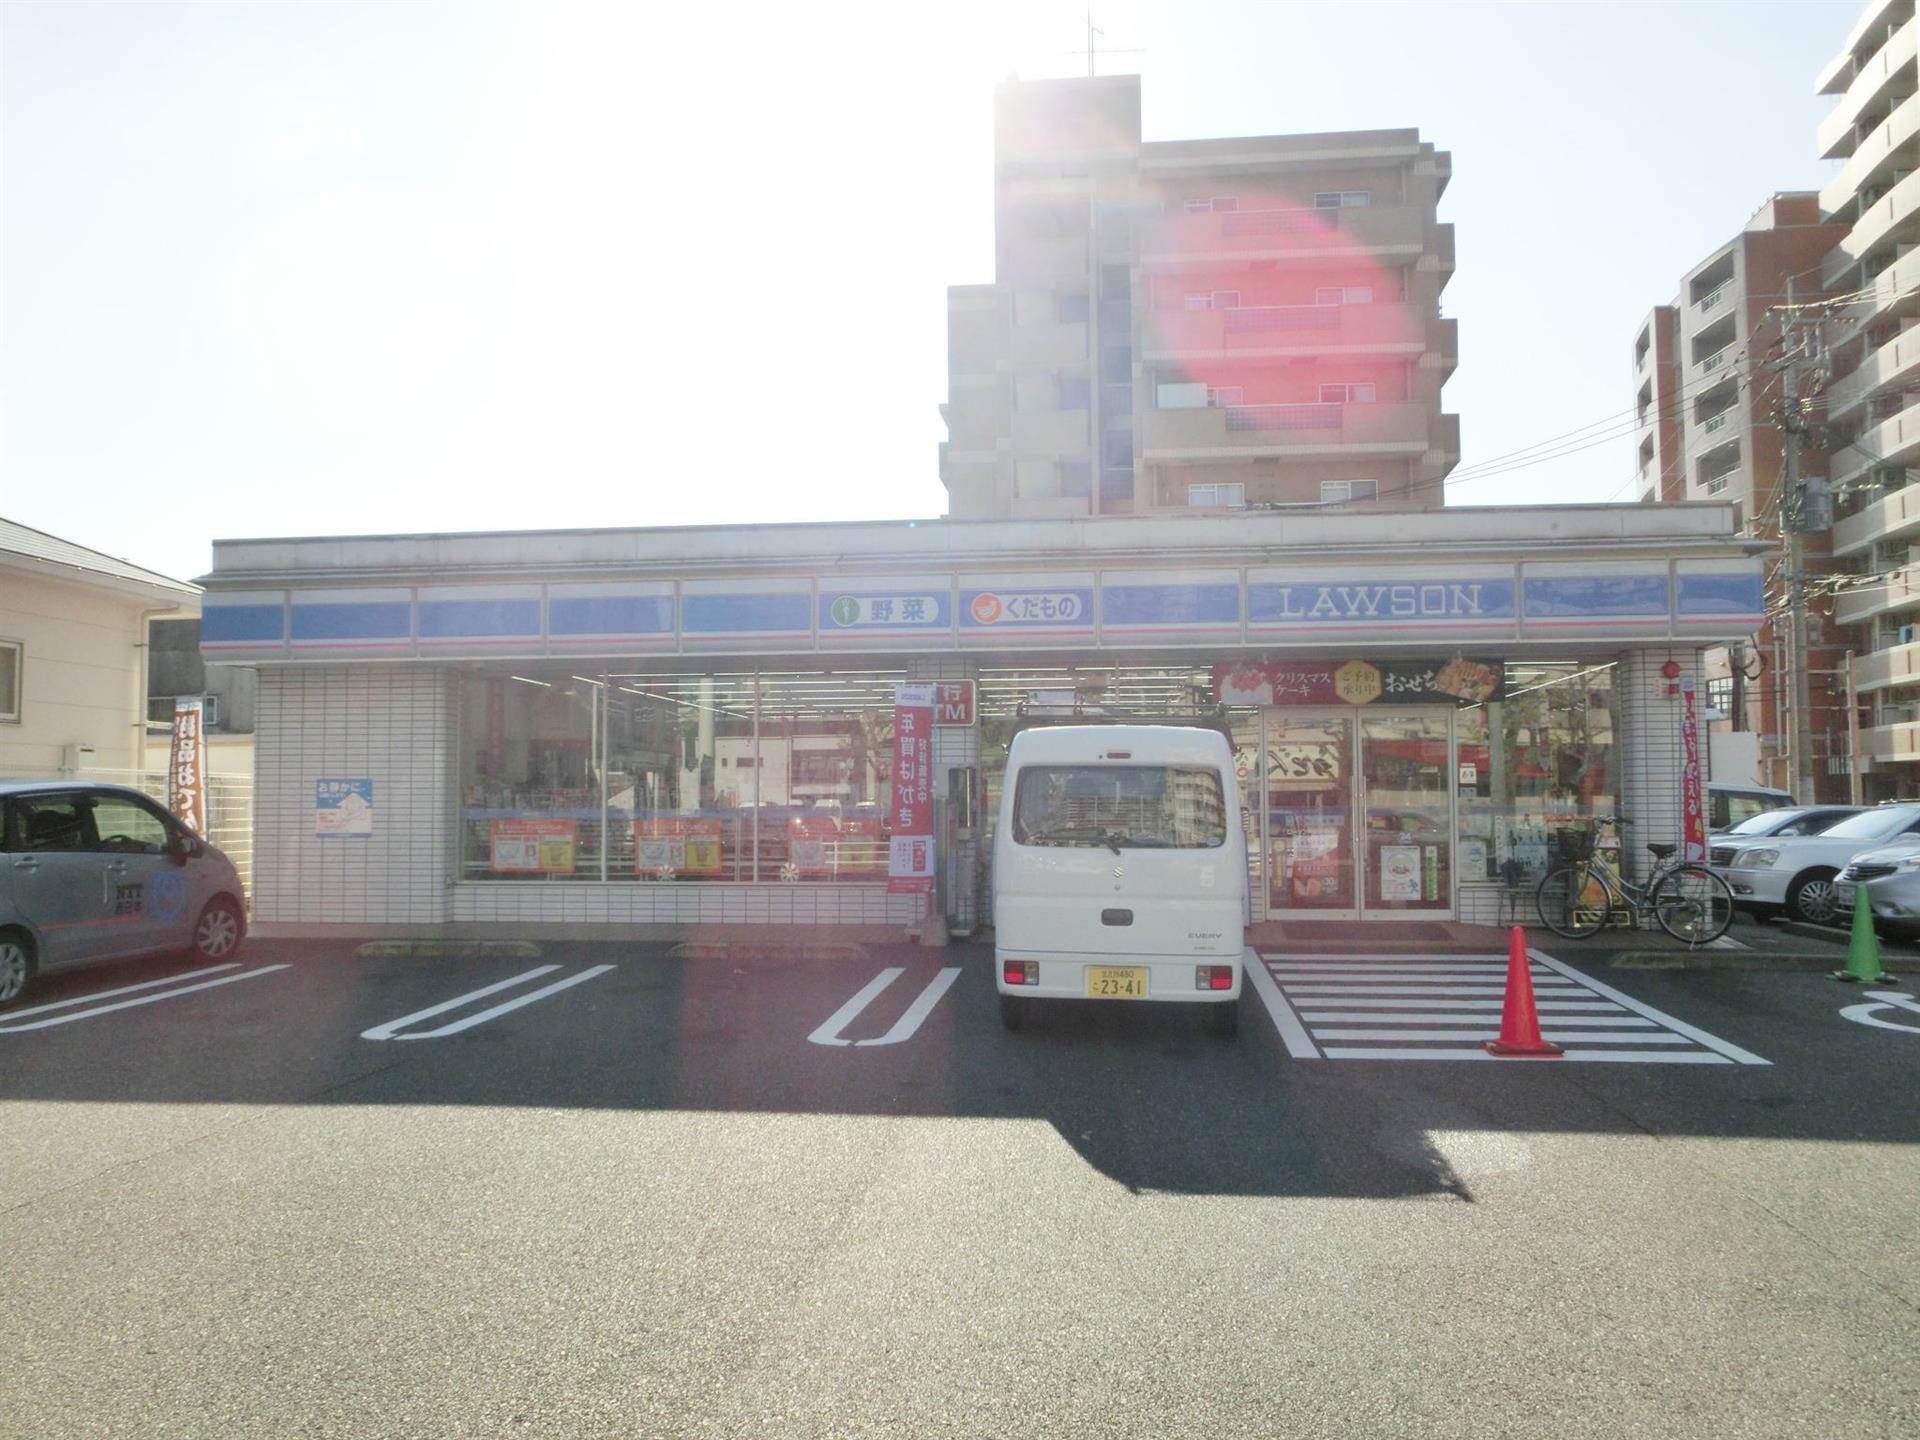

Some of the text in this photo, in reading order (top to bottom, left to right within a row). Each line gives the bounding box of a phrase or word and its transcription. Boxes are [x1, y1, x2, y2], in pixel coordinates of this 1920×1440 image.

[1005, 596, 1076, 621] くだもの
[1279, 584, 1484, 618] LAWSON
[870, 598, 926, 622] 野菜
[1275, 671, 1331, 685] クリスマス
[1342, 671, 1376, 683] ご予約
[1385, 670, 1439, 694] おせち
[1275, 684, 1311, 697] ケーキ
[115, 884, 142, 899] NTT
[1187, 932, 1223, 940] EVERY
[1100, 979, 1142, 995] 23-41
